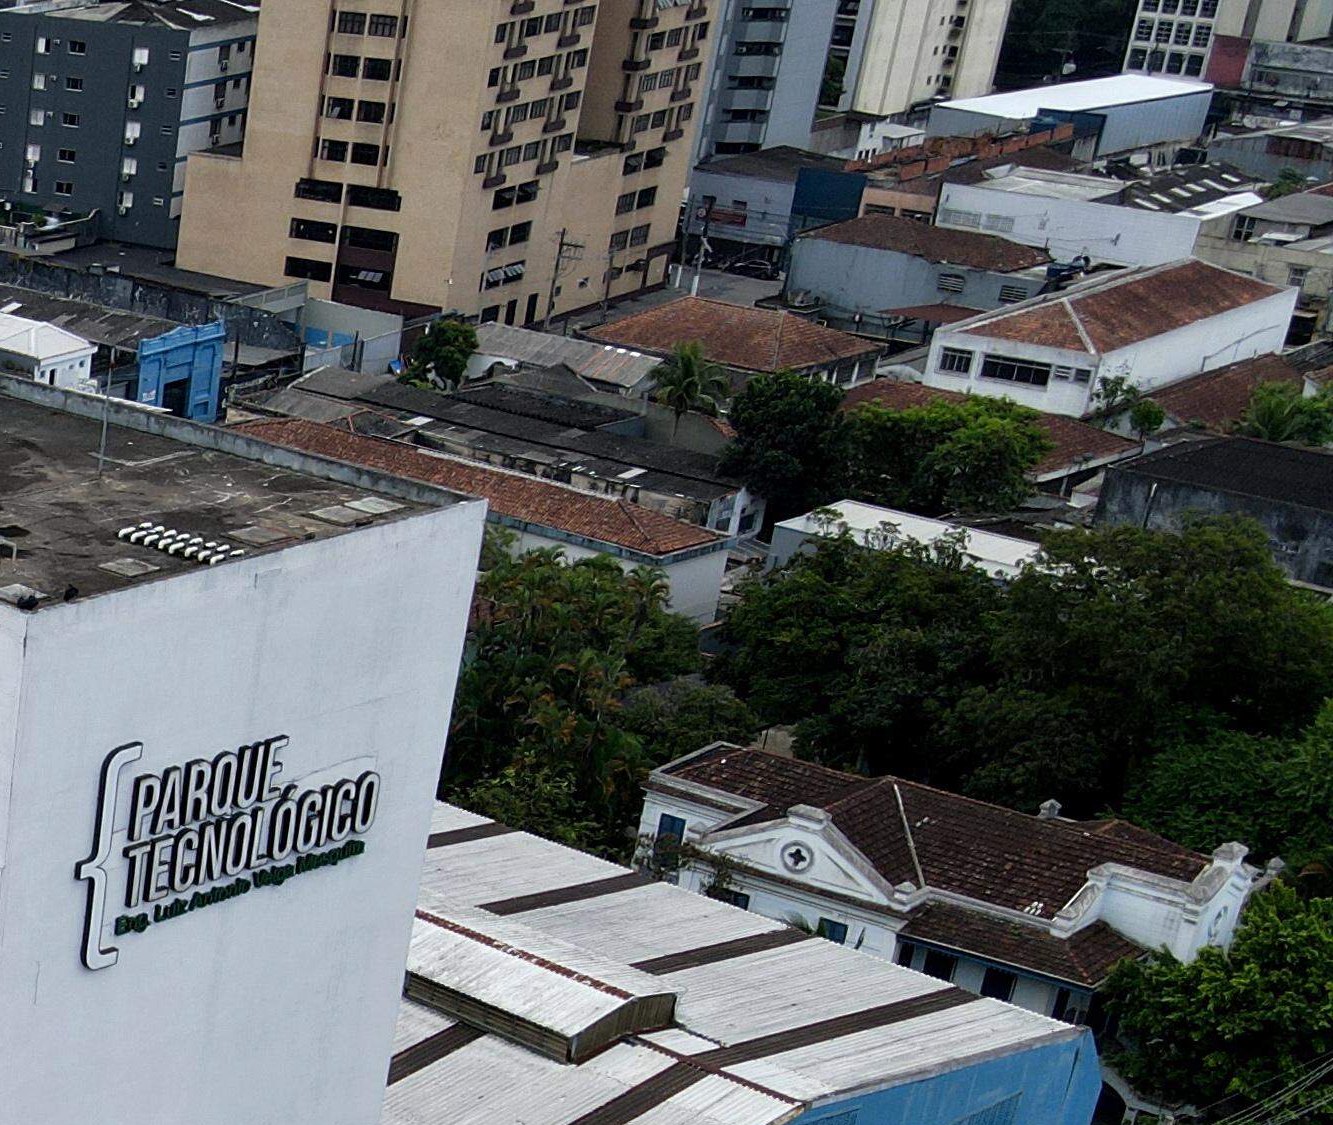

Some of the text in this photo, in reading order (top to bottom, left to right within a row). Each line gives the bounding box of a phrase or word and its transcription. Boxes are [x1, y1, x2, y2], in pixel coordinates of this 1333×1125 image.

[123, 770, 381, 908] TECNOLÓGICO
[128, 735, 289, 841] PARQUE
[114, 912, 151, 936] Eng.
